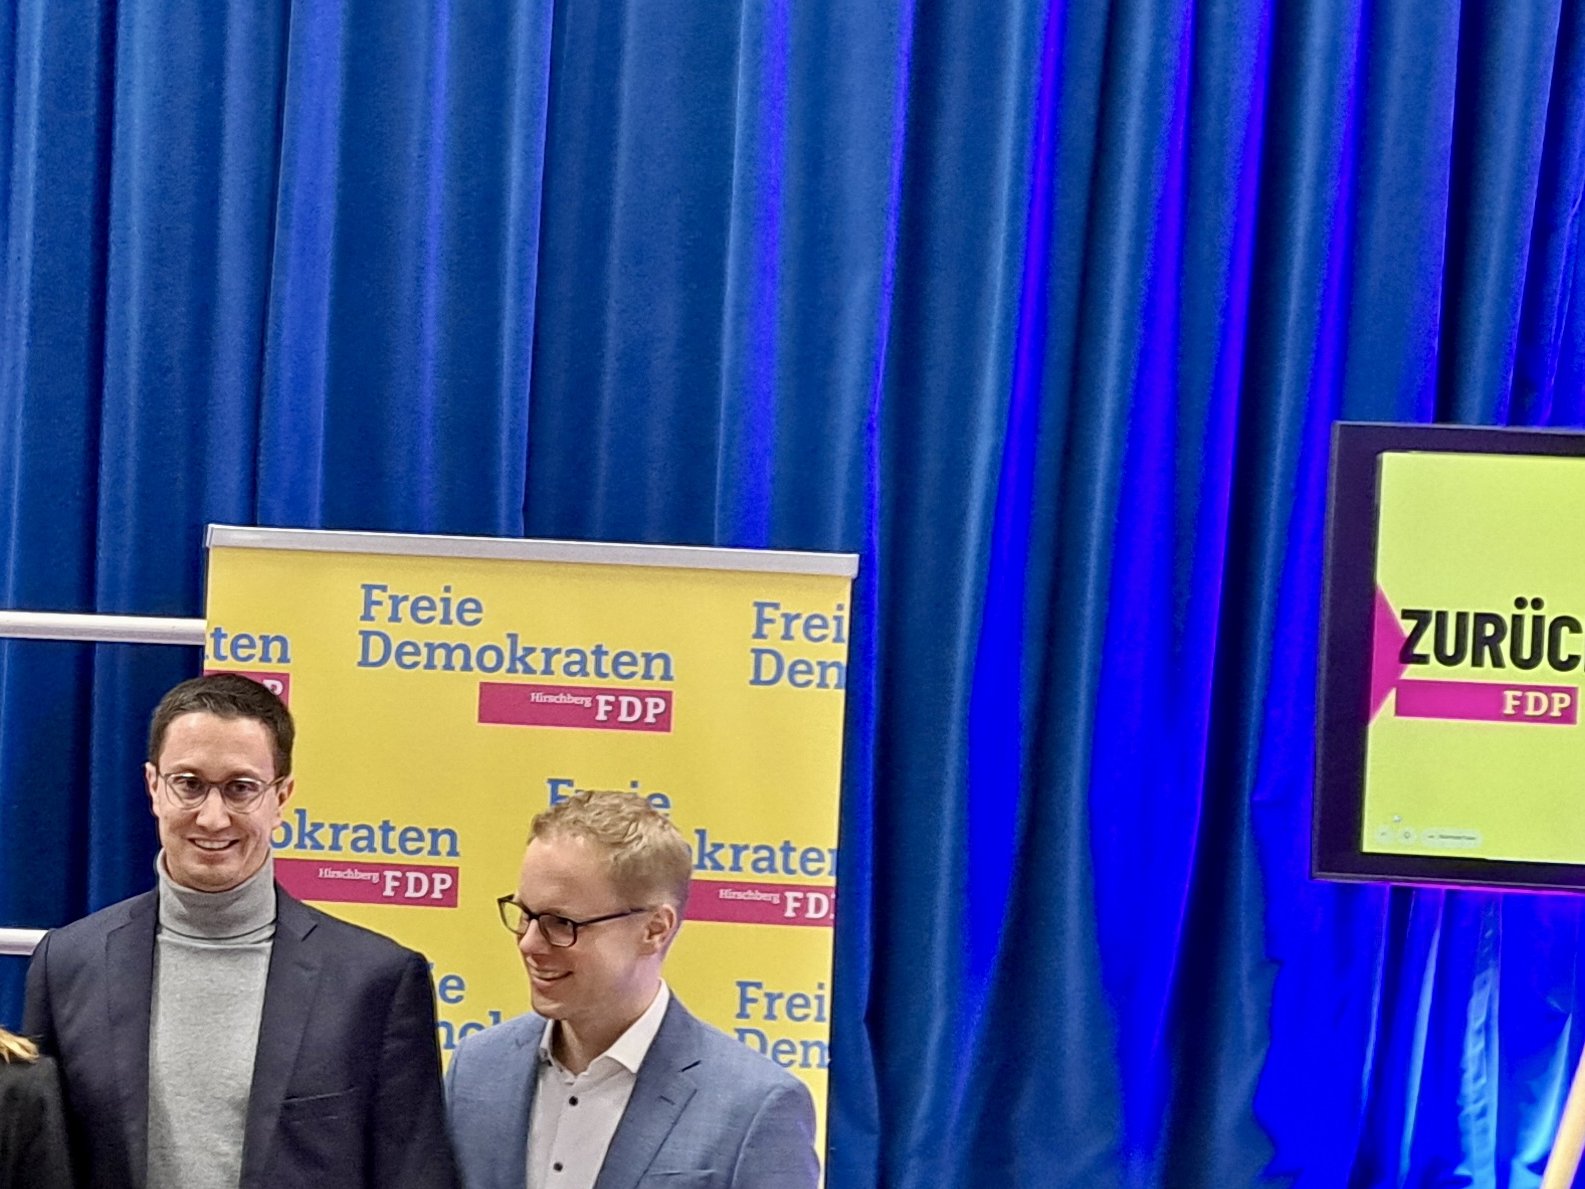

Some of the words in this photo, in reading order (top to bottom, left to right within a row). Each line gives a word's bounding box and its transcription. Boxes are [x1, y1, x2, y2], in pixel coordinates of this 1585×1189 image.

[360, 584, 483, 626] Freie
[751, 601, 846, 643] Frei
[207, 627, 291, 663] ten
[1399, 596, 1585, 672] ZURÜC
[357, 630, 674, 681] Demokraten
[531, 692, 592, 707] Hirschberg
[595, 694, 666, 723] FDP
[1503, 690, 1572, 717] FDP
[694, 829, 837, 876] krate
[319, 869, 379, 884] Hirschberg
[383, 870, 452, 899] FDP
[784, 891, 835, 918] FD
[735, 981, 827, 1022] Frei
